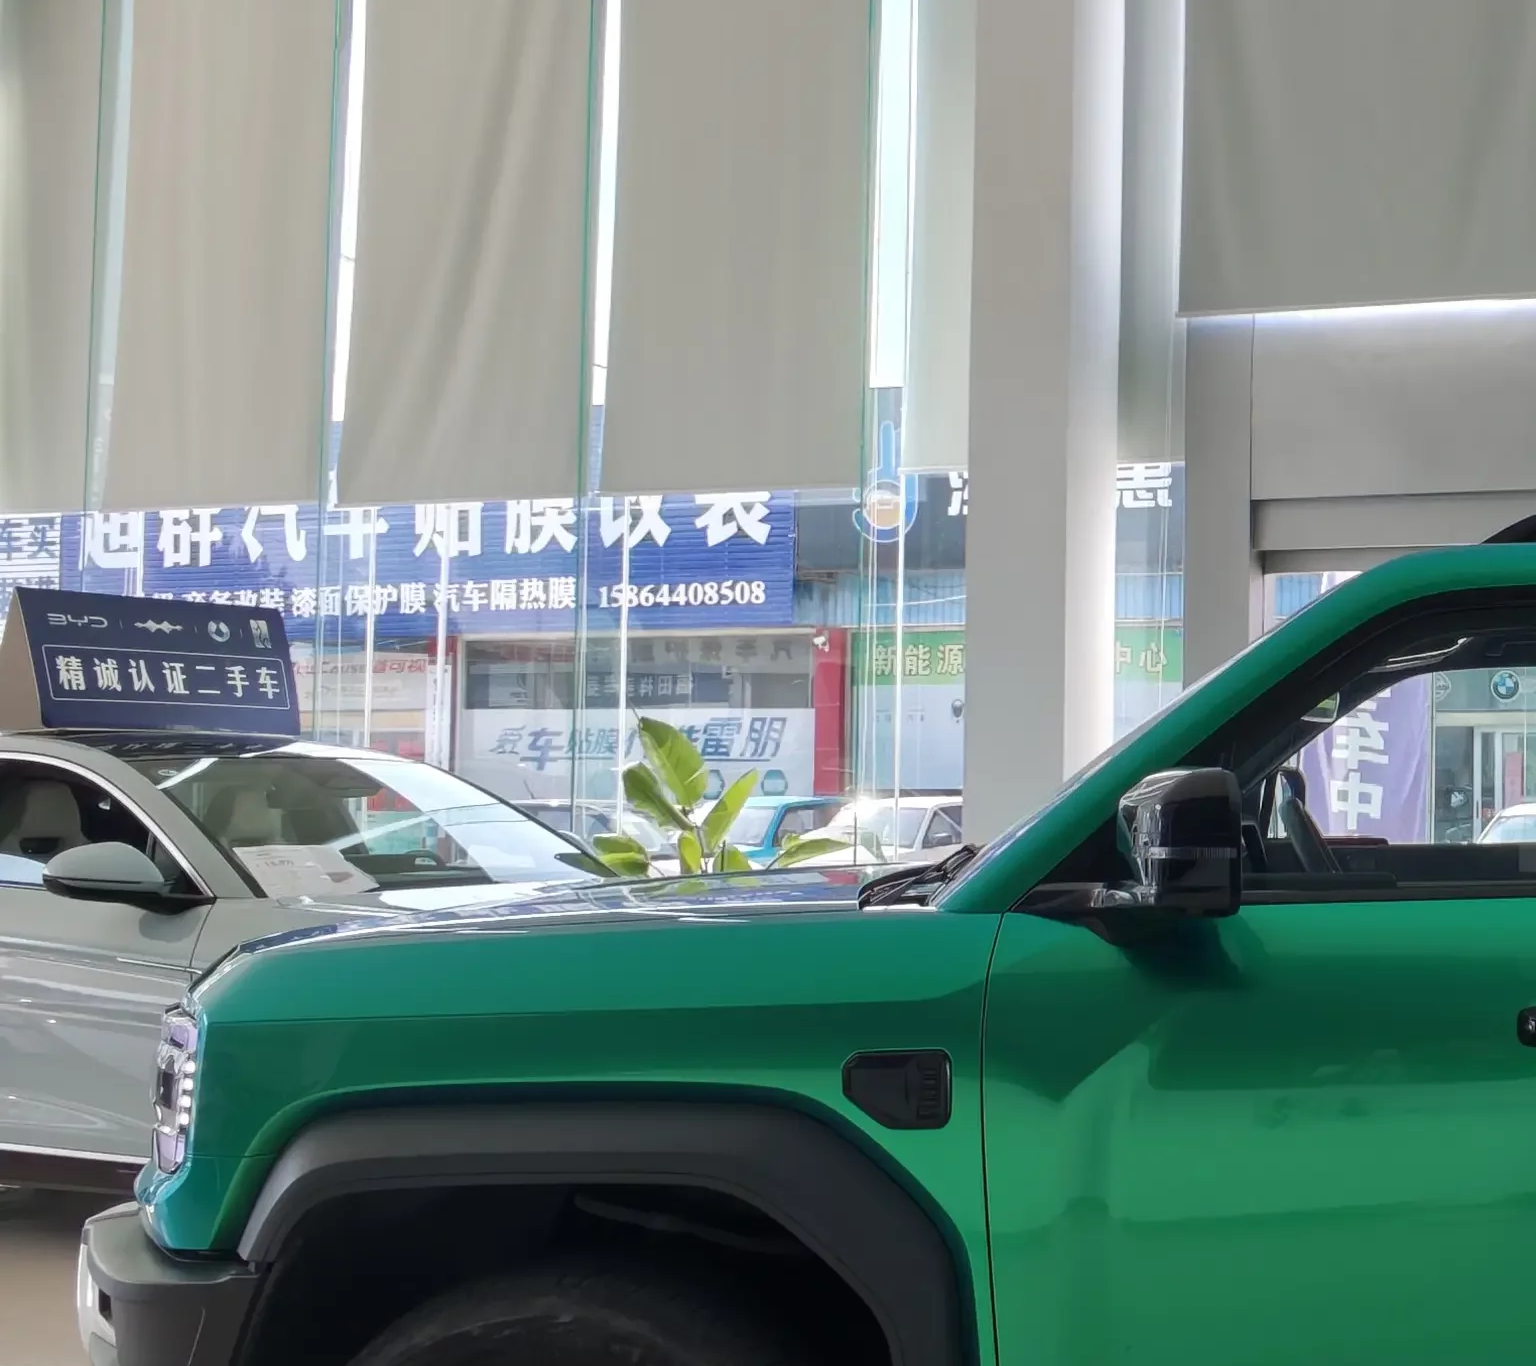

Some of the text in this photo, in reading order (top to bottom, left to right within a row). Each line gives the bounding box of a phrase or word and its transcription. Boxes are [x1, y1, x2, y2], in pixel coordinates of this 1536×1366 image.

[433, 575, 577, 613] 汽车隔热膜
[598, 580, 766, 609] 15864408508
[55, 655, 281, 701] 精诚认证二手车
[874, 643, 965, 676] 新能源
